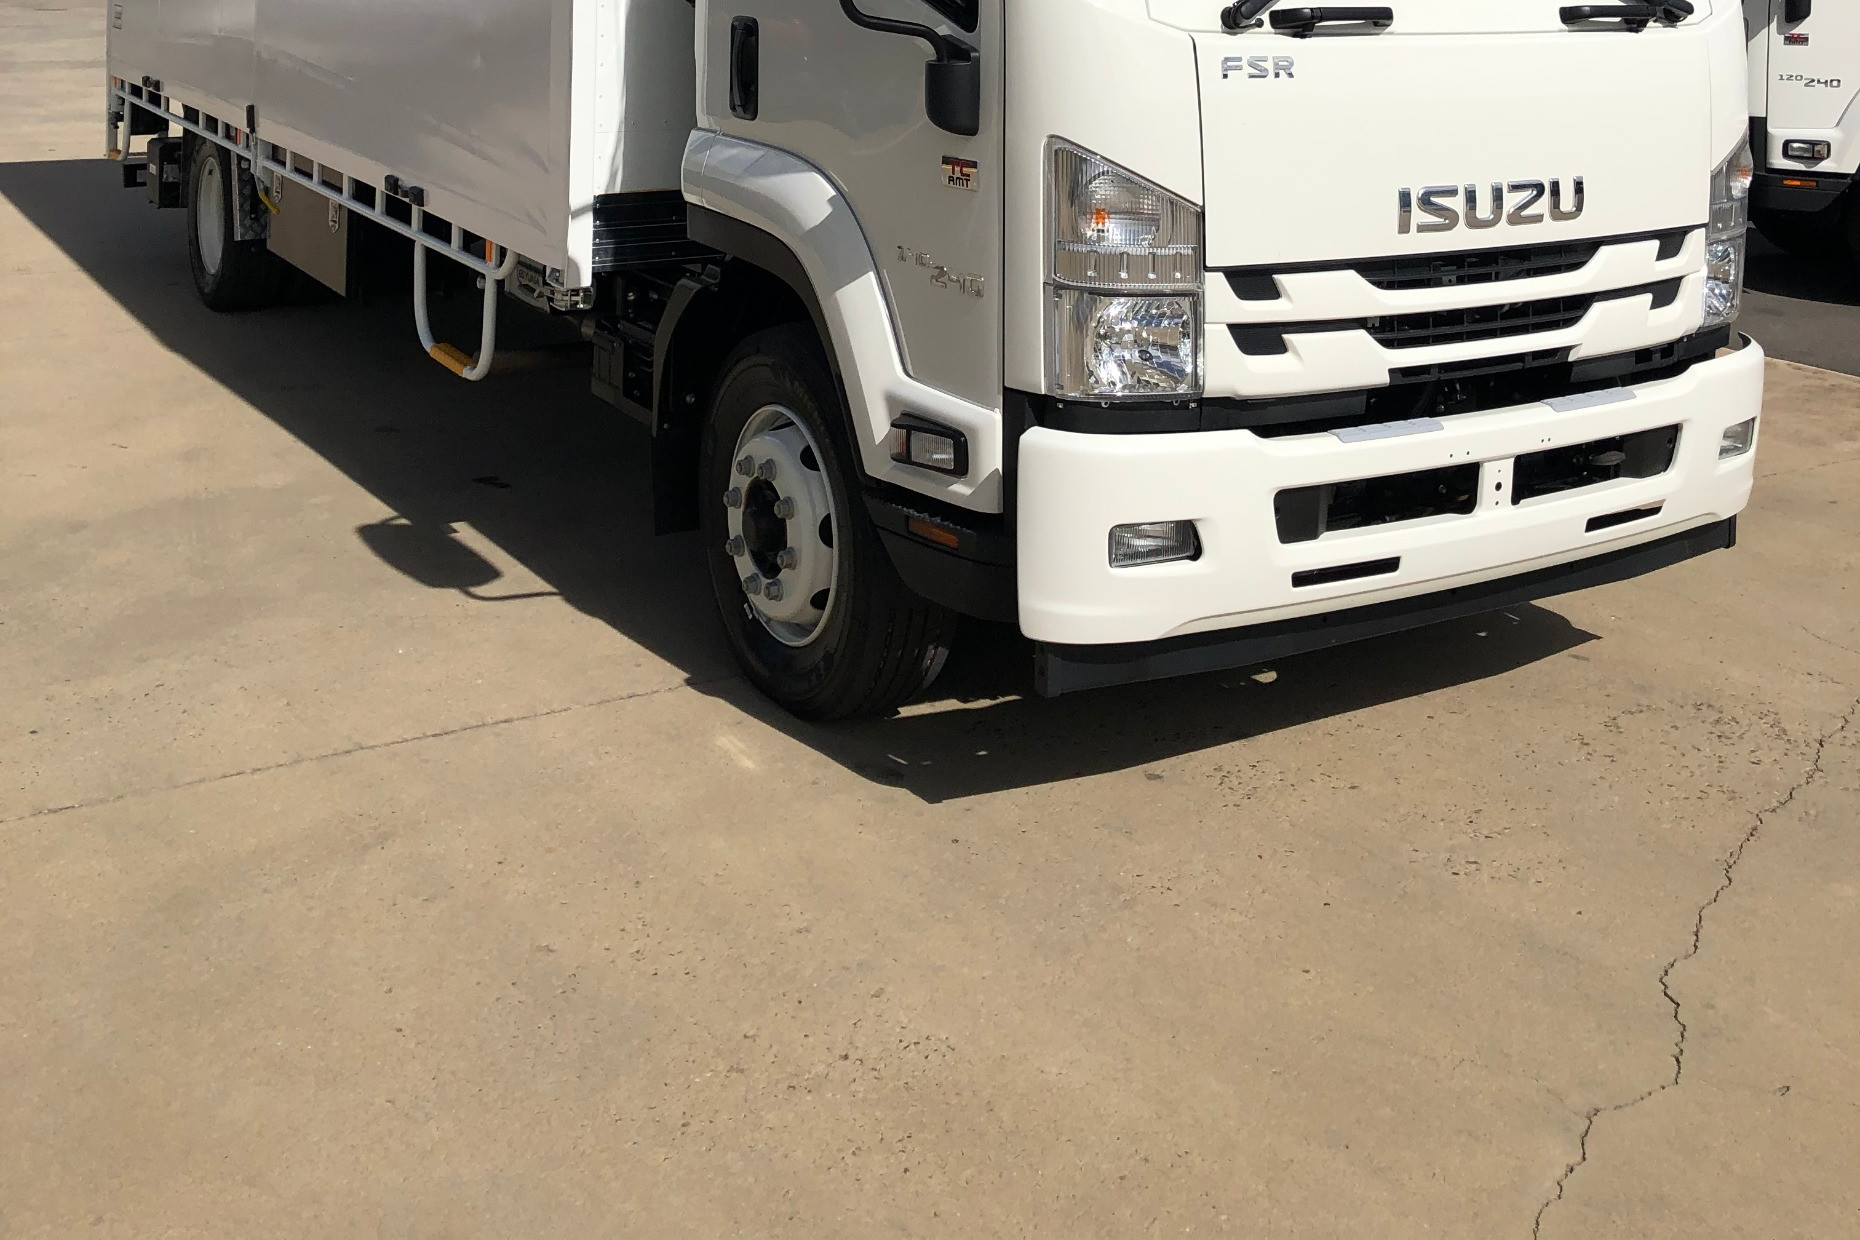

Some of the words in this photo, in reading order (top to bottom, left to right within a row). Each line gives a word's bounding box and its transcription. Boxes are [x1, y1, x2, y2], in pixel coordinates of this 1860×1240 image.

[1221, 55, 1295, 79] FSR
[1778, 73, 1803, 81] 120
[1803, 77, 1841, 88] 240
[949, 158, 971, 178] TC
[947, 175, 971, 189] AMT
[1397, 175, 1584, 235] ISUZU
[930, 265, 985, 298] 240
